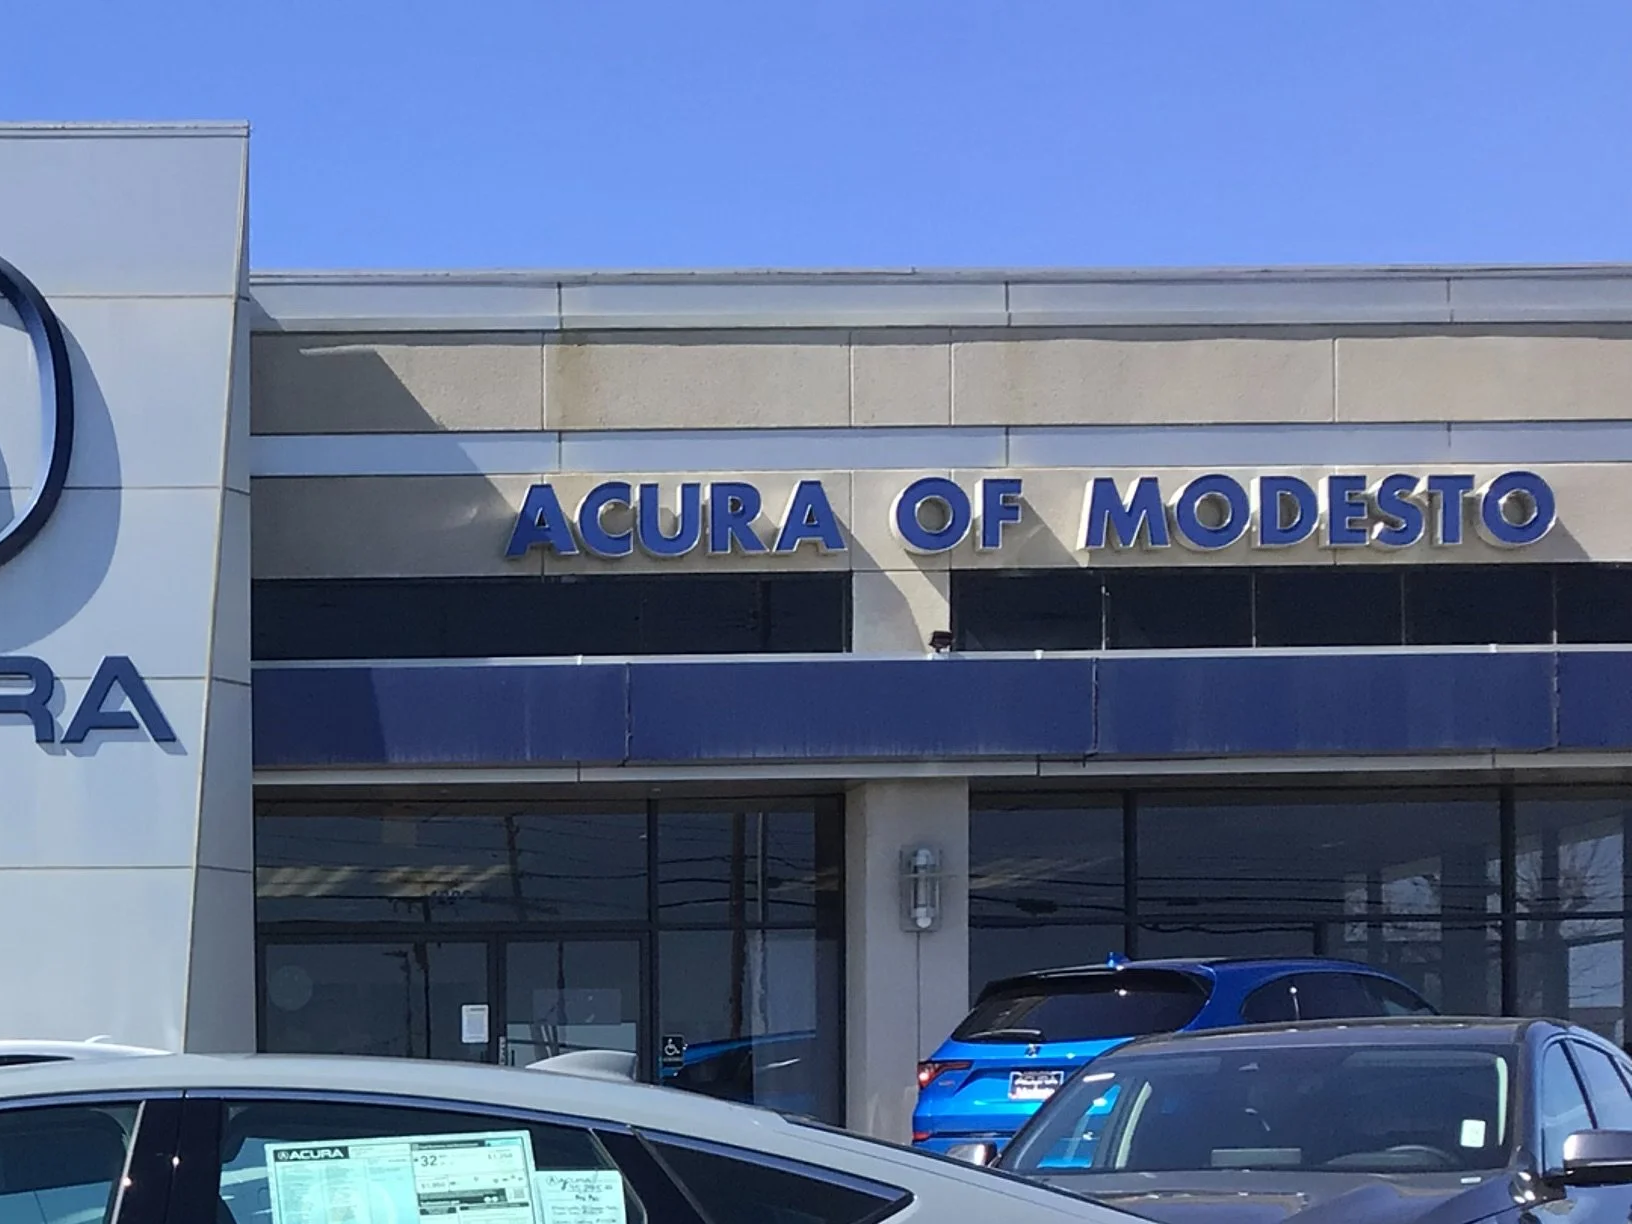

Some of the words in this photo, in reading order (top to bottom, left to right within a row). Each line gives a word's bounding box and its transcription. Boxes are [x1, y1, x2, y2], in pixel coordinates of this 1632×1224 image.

[505, 479, 846, 557] ACURA
[892, 476, 1023, 554] OF
[1084, 470, 1557, 552] MODESTO
[289, 1148, 344, 1160] ACURA
[420, 1155, 438, 1167] 32
